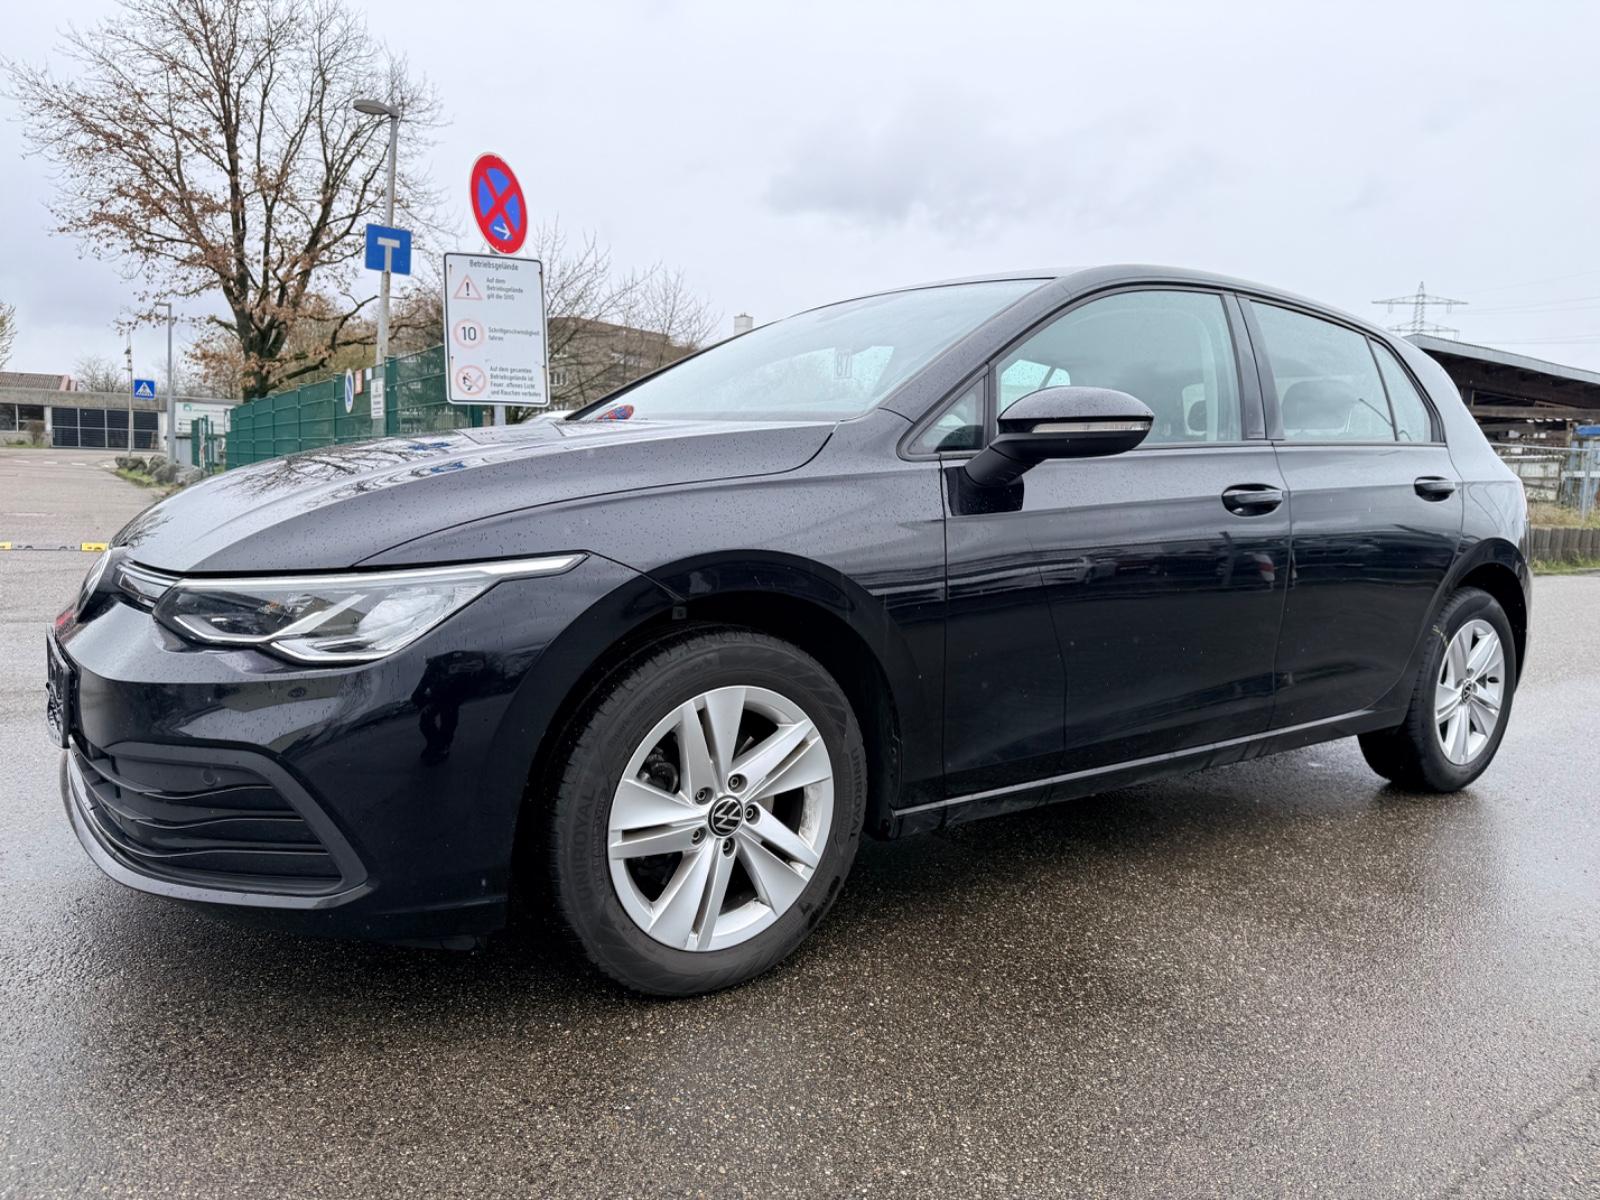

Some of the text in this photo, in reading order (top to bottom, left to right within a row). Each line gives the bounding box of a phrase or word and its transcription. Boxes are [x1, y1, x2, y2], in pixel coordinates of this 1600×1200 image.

[469, 259, 519, 271] Betriebsgelände
[461, 326, 477, 341] 10
[849, 748, 864, 843] UNIROYAL
[571, 789, 596, 899] UNIROYAL
